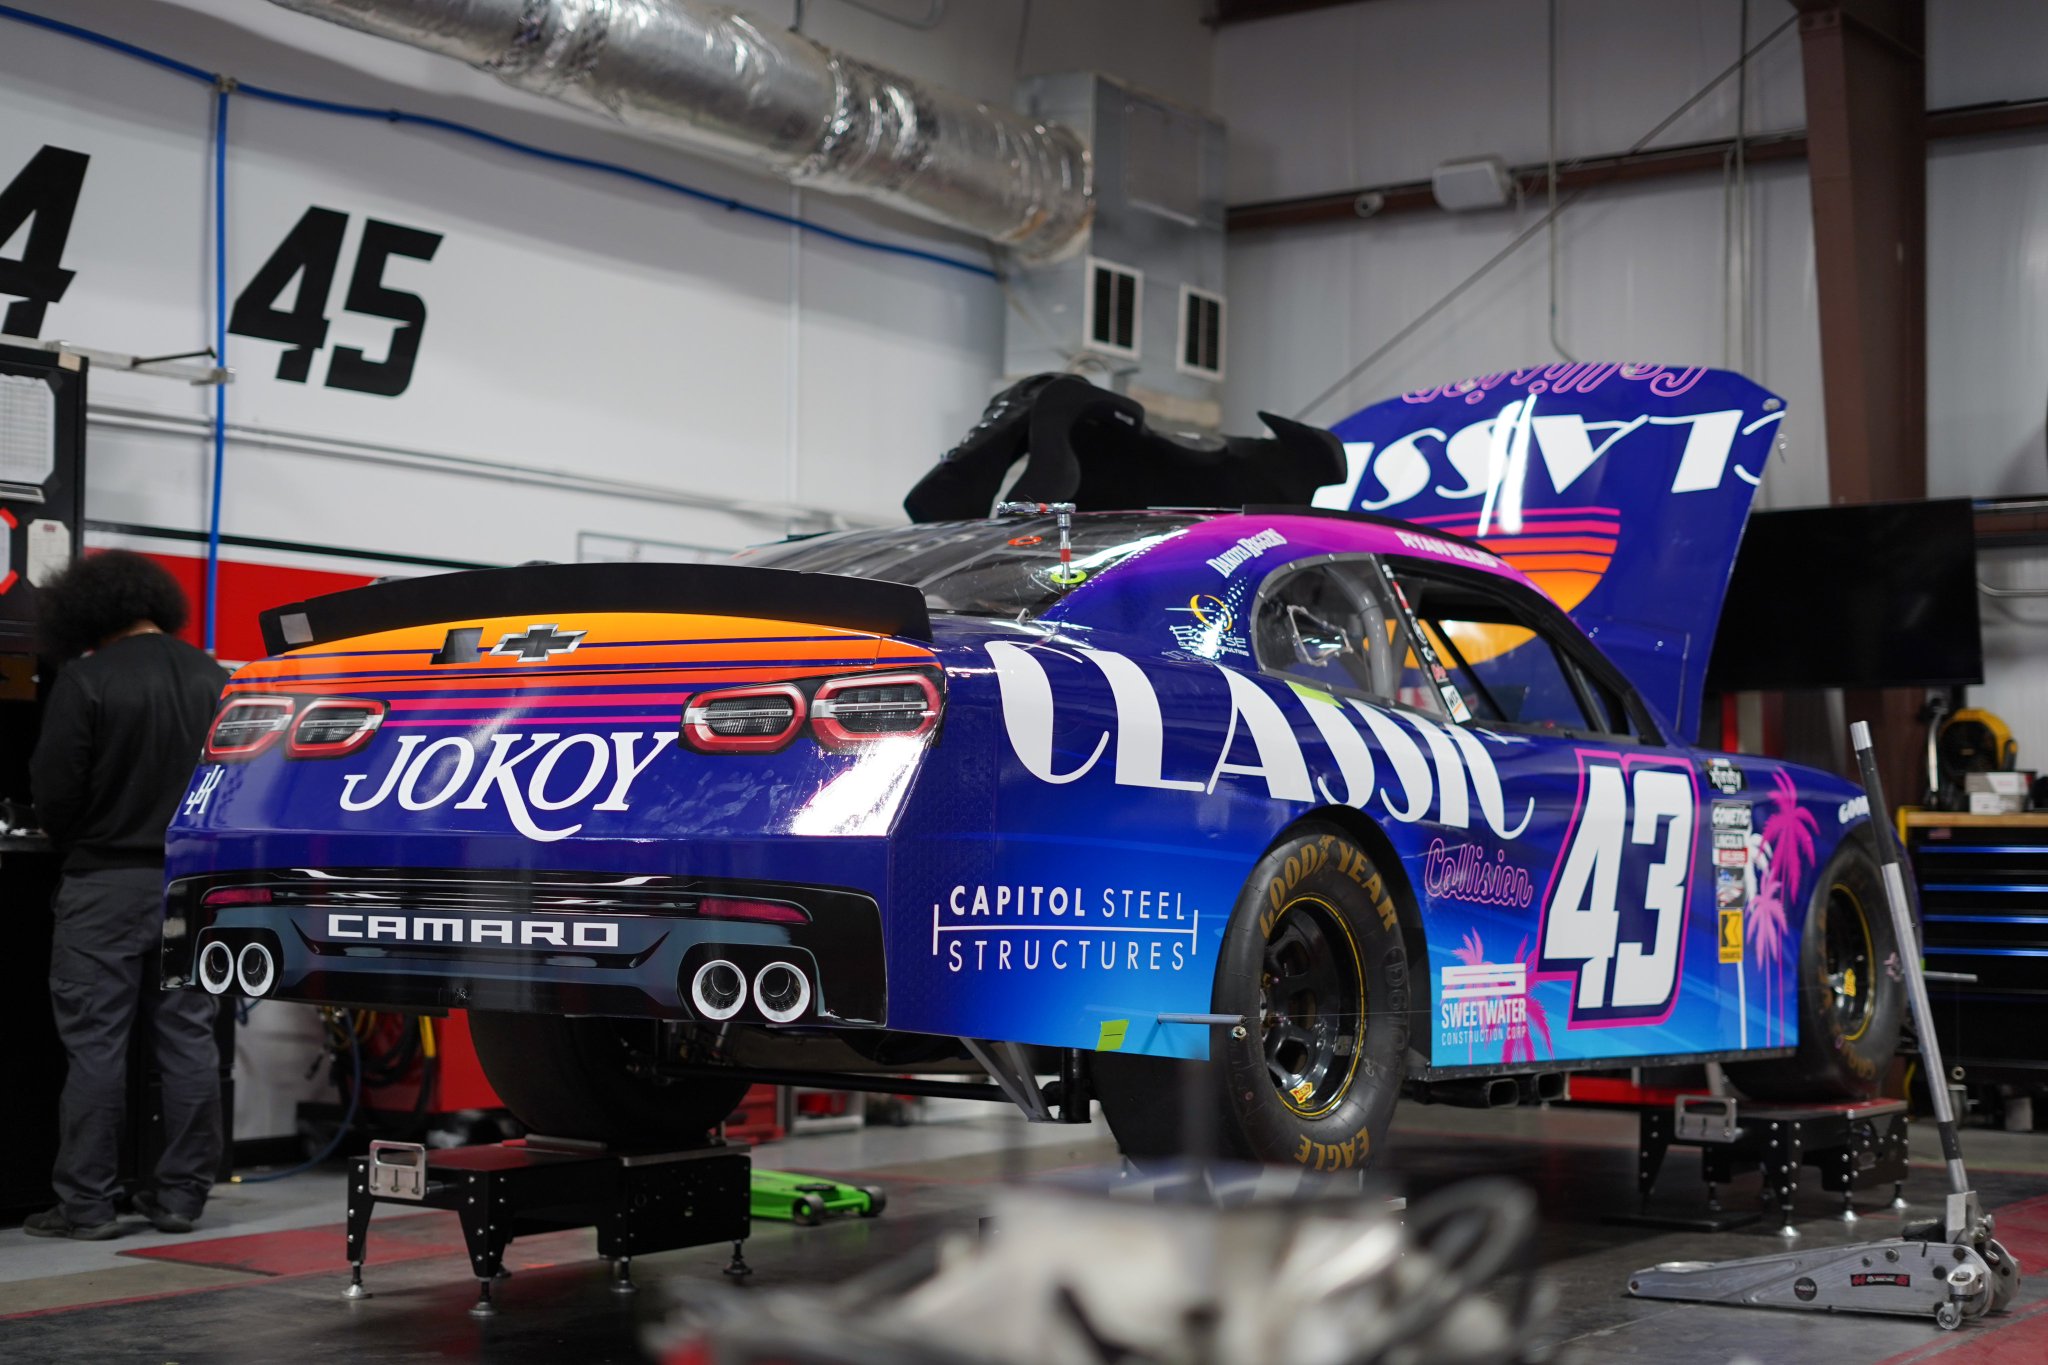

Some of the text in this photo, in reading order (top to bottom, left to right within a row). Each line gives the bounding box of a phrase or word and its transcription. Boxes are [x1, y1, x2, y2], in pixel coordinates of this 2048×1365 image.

[228, 205, 444, 397] 45
[1206, 528, 1287, 578] DAKOTA RIGGERS
[1395, 531, 1450, 557] RYAN
[983, 640, 1535, 840] CLASSIC
[340, 731, 678, 842] JOKOY
[1424, 837, 1533, 908] Collision
[1544, 764, 1693, 1009] 43
[949, 885, 1186, 920] CAPITOL STEEL
[328, 914, 619, 947] CAMARO
[948, 939, 1185, 972] STRUCTURES
[1441, 998, 1527, 1029] SWEETWATER
[1441, 1025, 1527, 1046] CONSTRUCTION CORP
[1294, 1125, 1370, 1172] EAGLE
